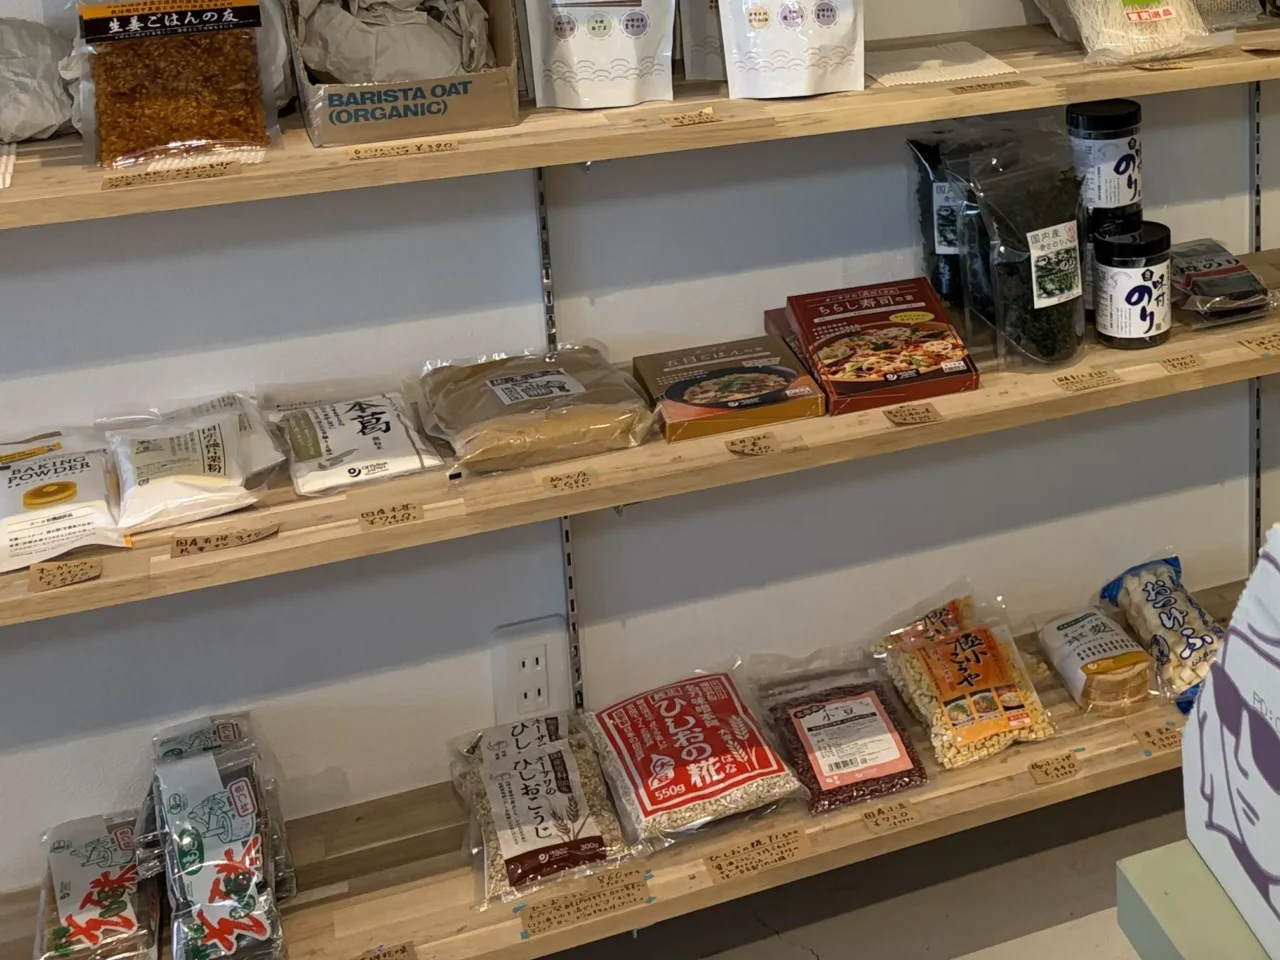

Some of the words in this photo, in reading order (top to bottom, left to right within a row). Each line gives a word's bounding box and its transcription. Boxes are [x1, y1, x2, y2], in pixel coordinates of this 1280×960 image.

[108, 7, 240, 34] 生姜ごはんの友
[328, 88, 428, 108] BARISTA
[430, 81, 473, 99] OAT
[328, 100, 448, 126] (ORGANIC)
[1113, 153, 1138, 202] のり
[1030, 228, 1061, 245] 国内産
[818, 295, 914, 316] ちらし寿司の素
[1124, 283, 1155, 335] のり
[1152, 273, 1166, 307] 味付
[344, 401, 392, 437] 本葛
[8, 462, 92, 485] POWDER
[11, 456, 87, 476] BAKING
[1141, 578, 1215, 661] おつゆふ
[822, 707, 857, 722] 小豆
[533, 754, 557, 796] オーサワの
[720, 753, 738, 774] はな
[512, 757, 553, 840] ひしおこうじ
[654, 783, 686, 802] 550g
[579, 841, 599, 851] 300g
